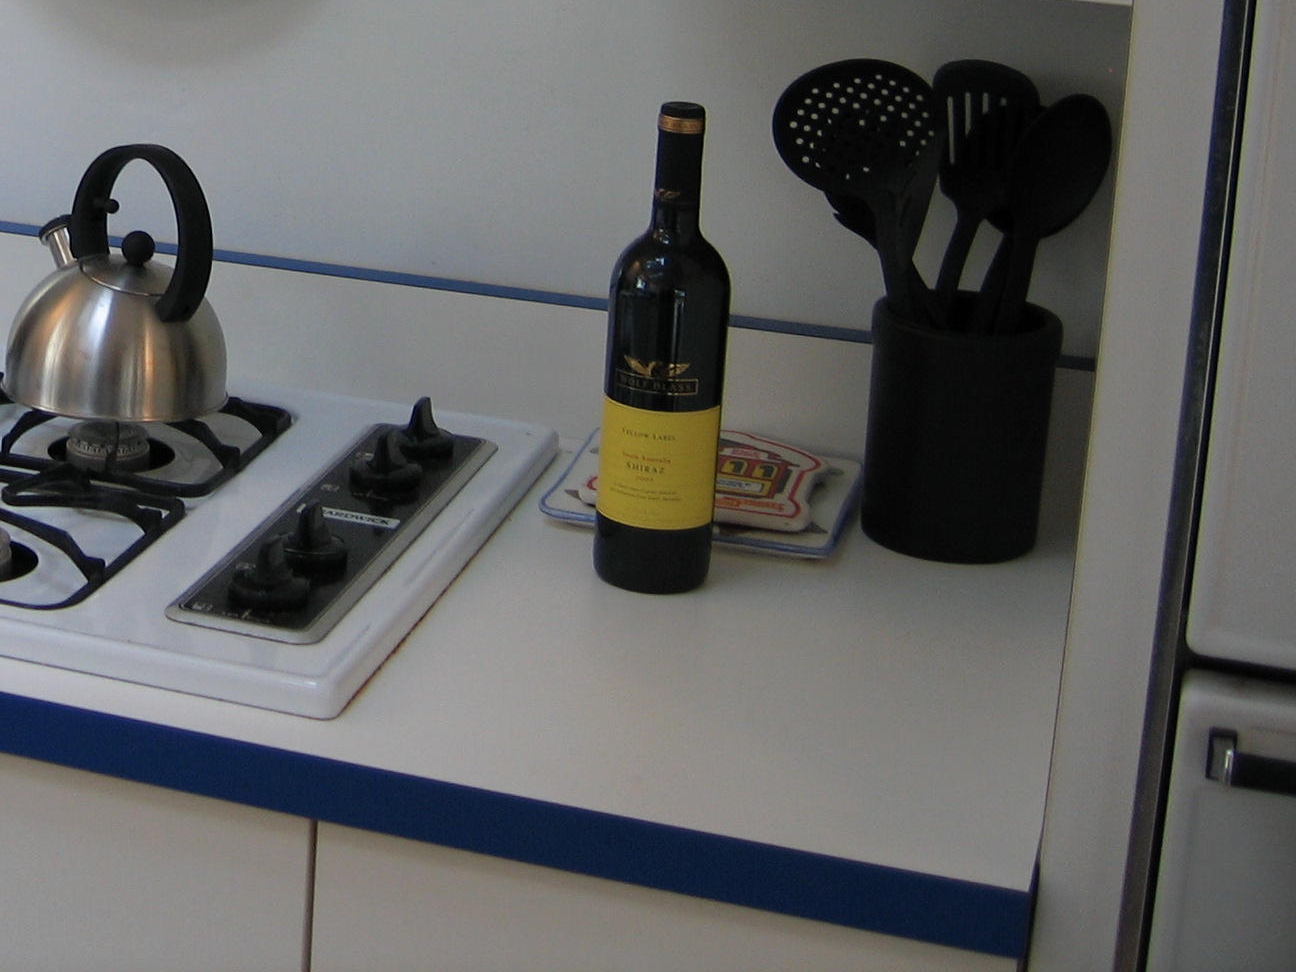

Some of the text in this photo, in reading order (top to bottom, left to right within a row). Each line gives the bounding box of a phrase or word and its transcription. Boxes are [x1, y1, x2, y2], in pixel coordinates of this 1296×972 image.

[619, 374, 692, 392] WOLF BLASS
[621, 427, 649, 438] YELLOW
[626, 461, 666, 475] SHIRAZ
[323, 509, 390, 526] ARDWICK
